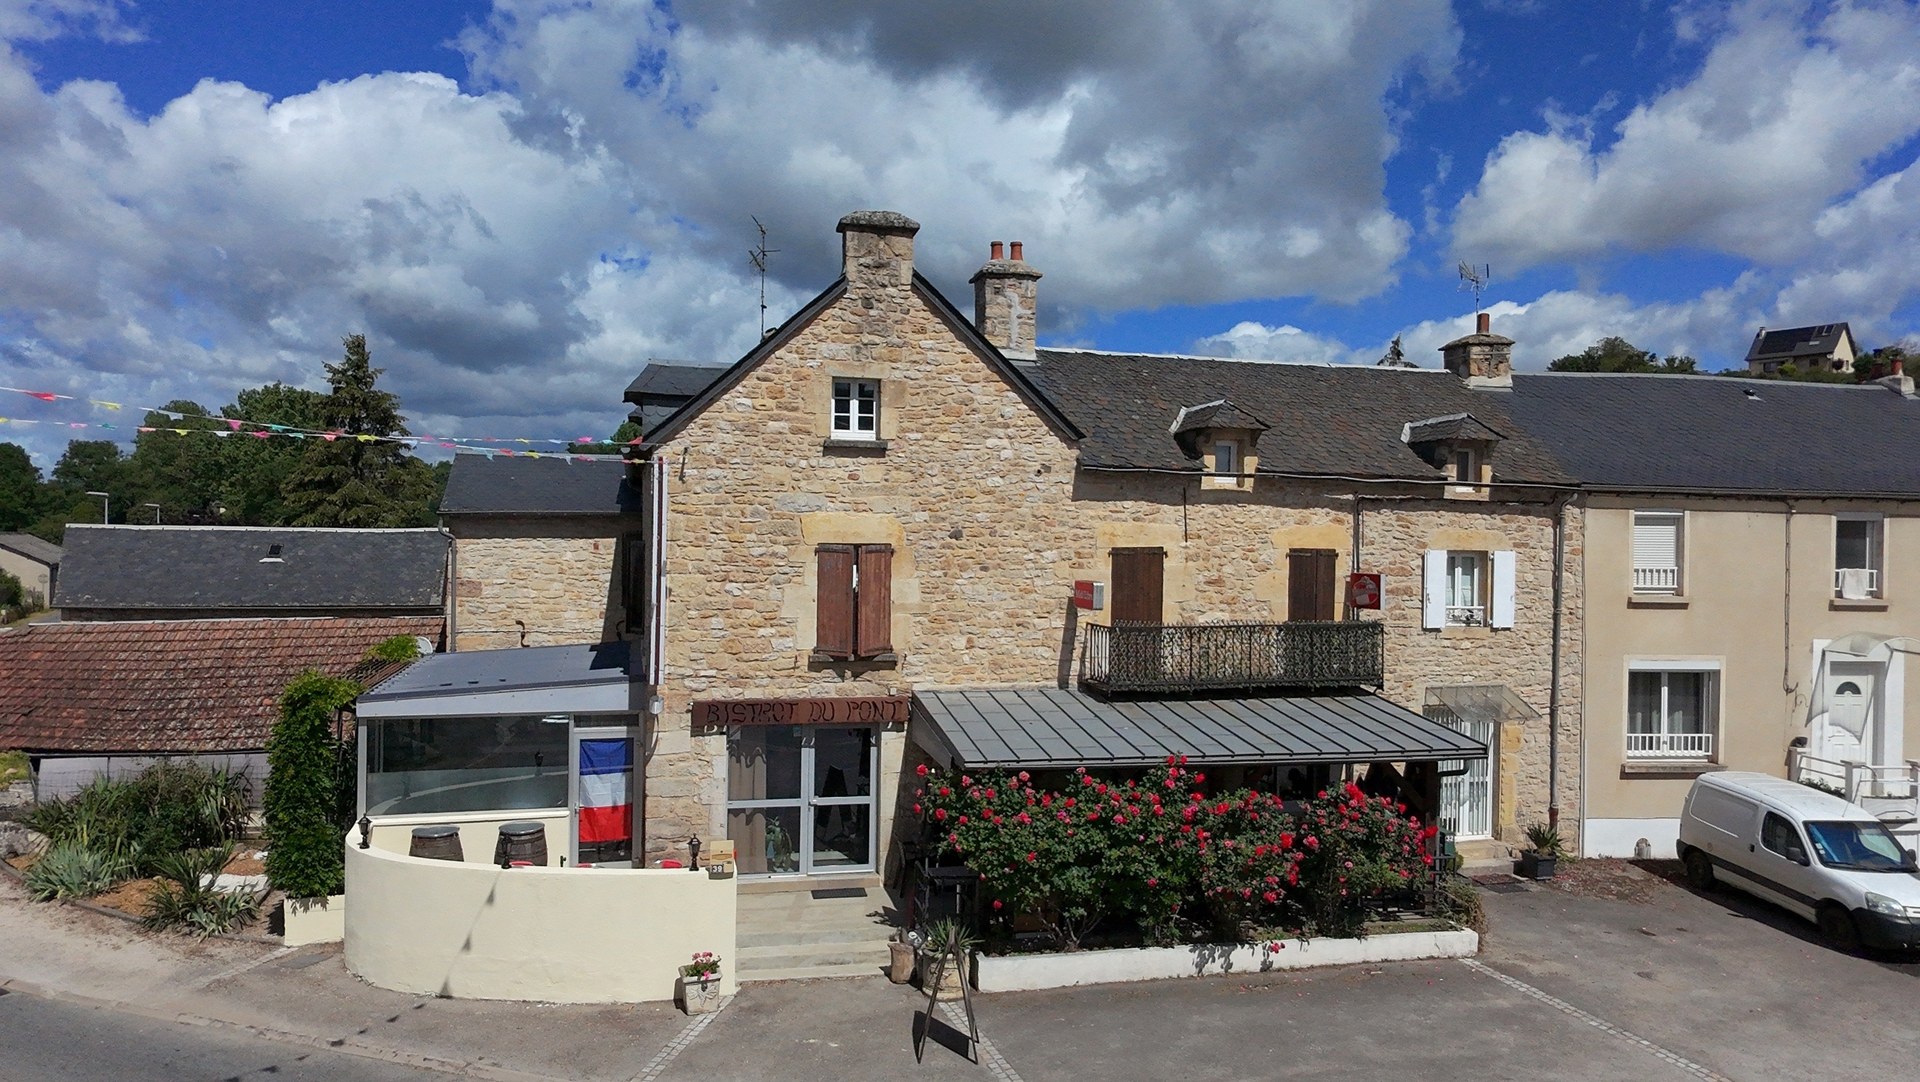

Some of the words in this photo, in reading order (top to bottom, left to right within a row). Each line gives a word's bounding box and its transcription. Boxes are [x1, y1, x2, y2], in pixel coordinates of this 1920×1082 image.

[707, 703, 798, 724] BISTROT
[808, 701, 836, 722] DU
[846, 700, 903, 723] PONT
